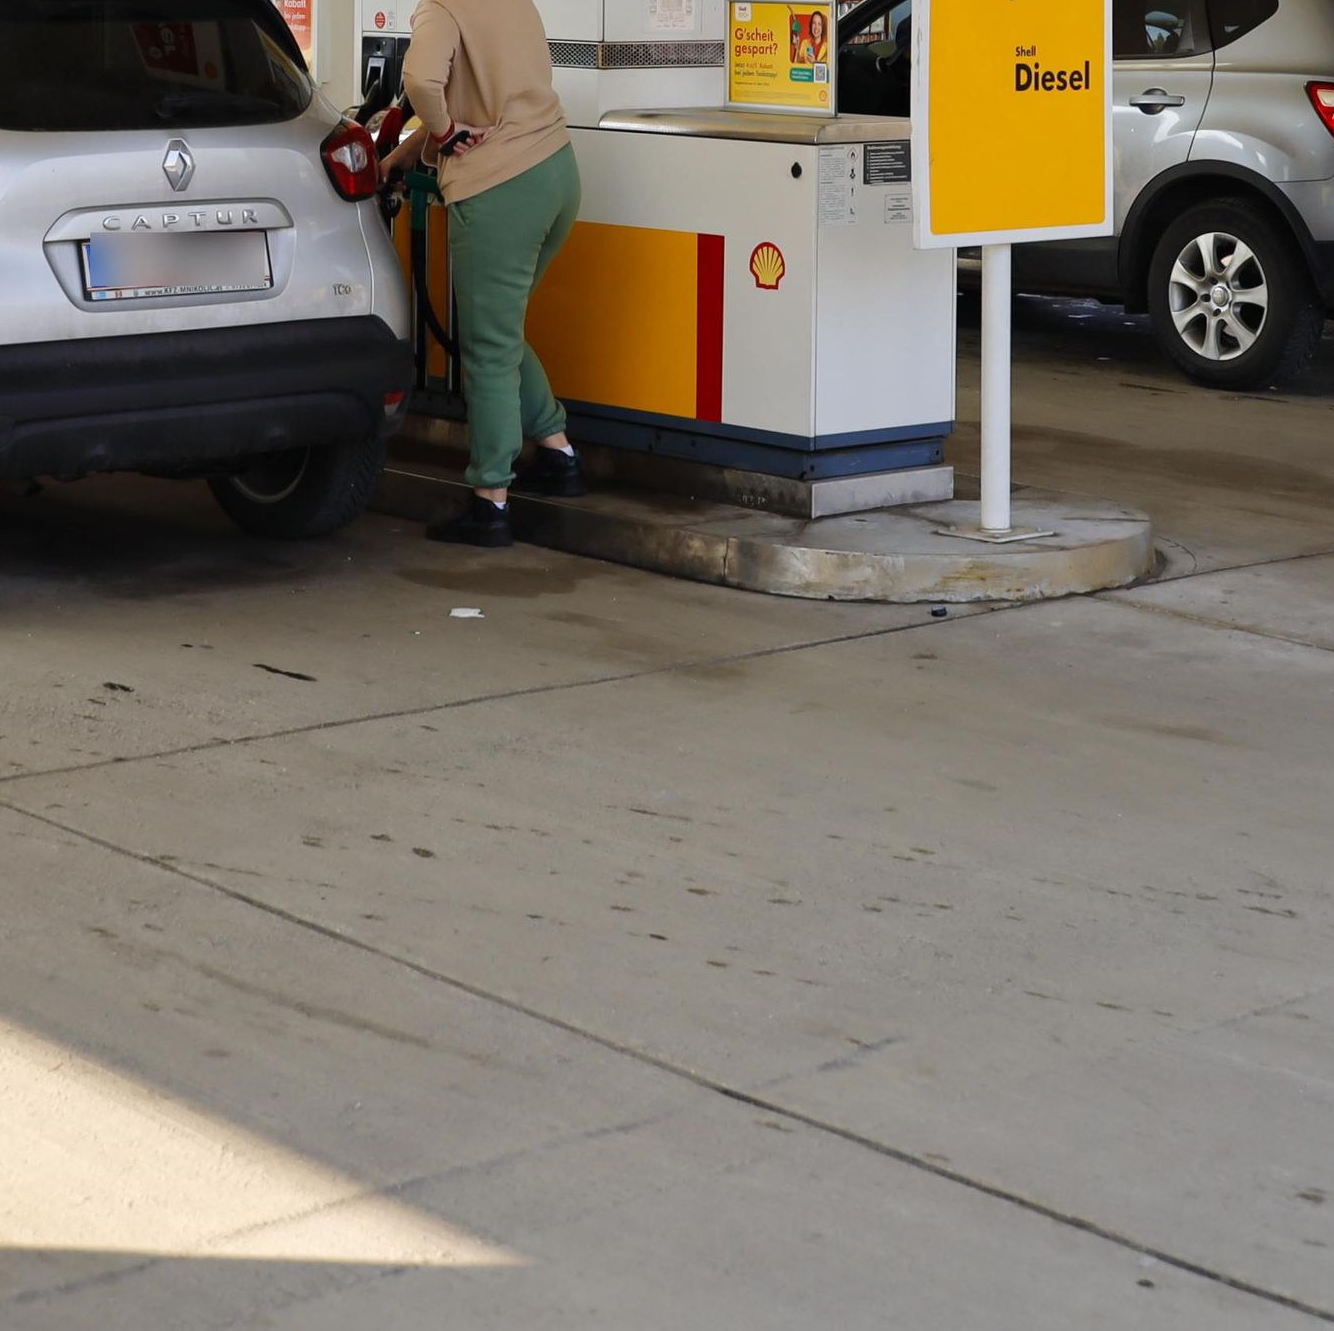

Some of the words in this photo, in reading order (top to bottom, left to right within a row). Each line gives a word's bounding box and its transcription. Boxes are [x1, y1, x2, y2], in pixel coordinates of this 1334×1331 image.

[735, 27, 773, 41] G'scheit
[735, 43, 778, 57] gespart?
[1015, 45, 1036, 57] Shell
[1015, 60, 1090, 91] Diesel
[102, 209, 258, 230] CAPTUR
